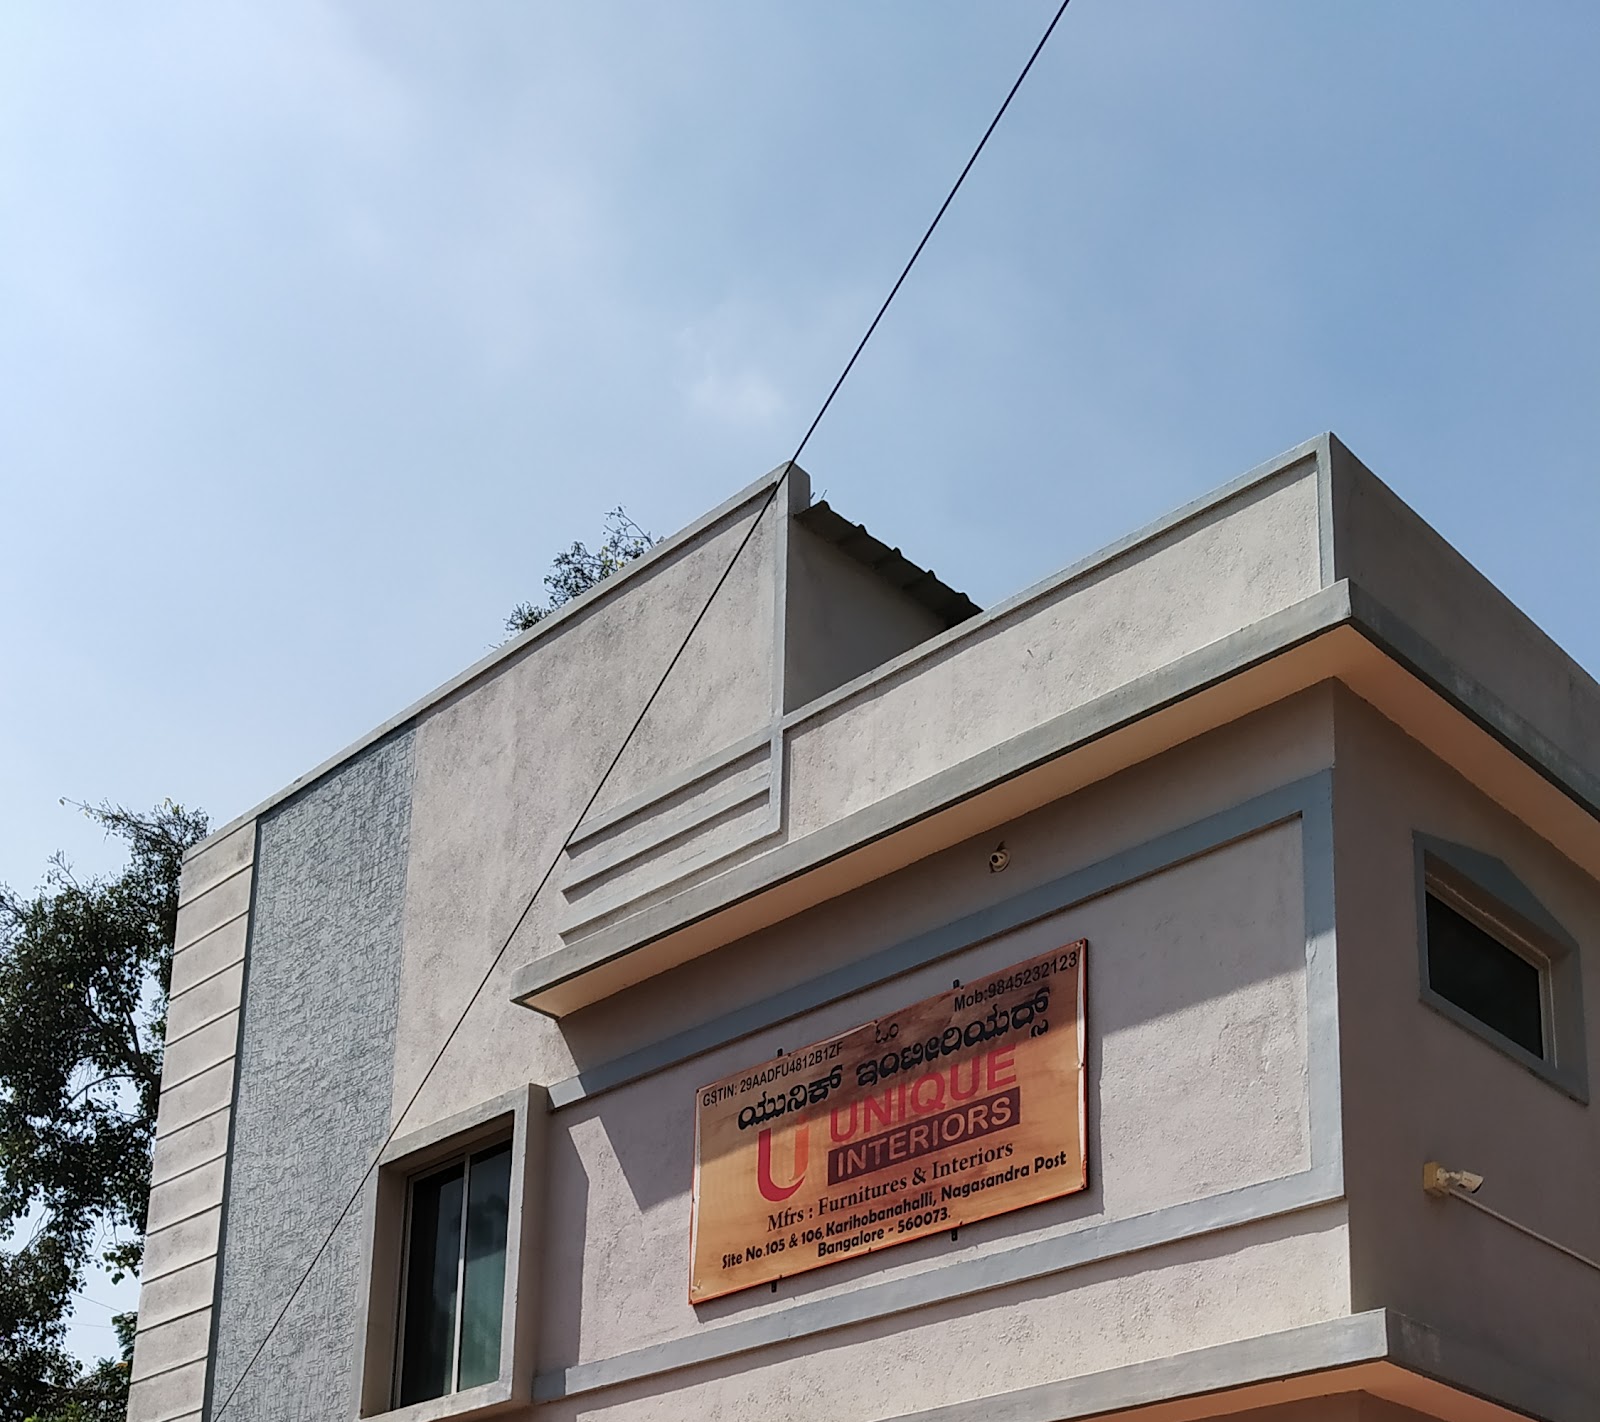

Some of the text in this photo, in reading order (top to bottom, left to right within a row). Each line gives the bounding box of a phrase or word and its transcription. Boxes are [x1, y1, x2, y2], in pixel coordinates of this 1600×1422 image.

[954, 951, 1078, 1013] Mob:9845232123
[702, 1042, 844, 1107] GSTIN: 29AADFU4812B1ZF
[830, 1044, 1018, 1143] UNIQUE
[836, 1096, 1013, 1179] INTERIORS
[722, 1253, 743, 1270] Site
[788, 1232, 798, 1250] &
[941, 1165, 1030, 1203] Nagasandra
[1034, 1150, 1067, 1174] Post
[818, 1176, 908, 1217] Furnitures
[911, 1167, 927, 1186] &
[932, 1142, 1014, 1181] Interiors
[818, 1226, 885, 1258] Bangalore
[897, 1206, 951, 1234] 560073.
